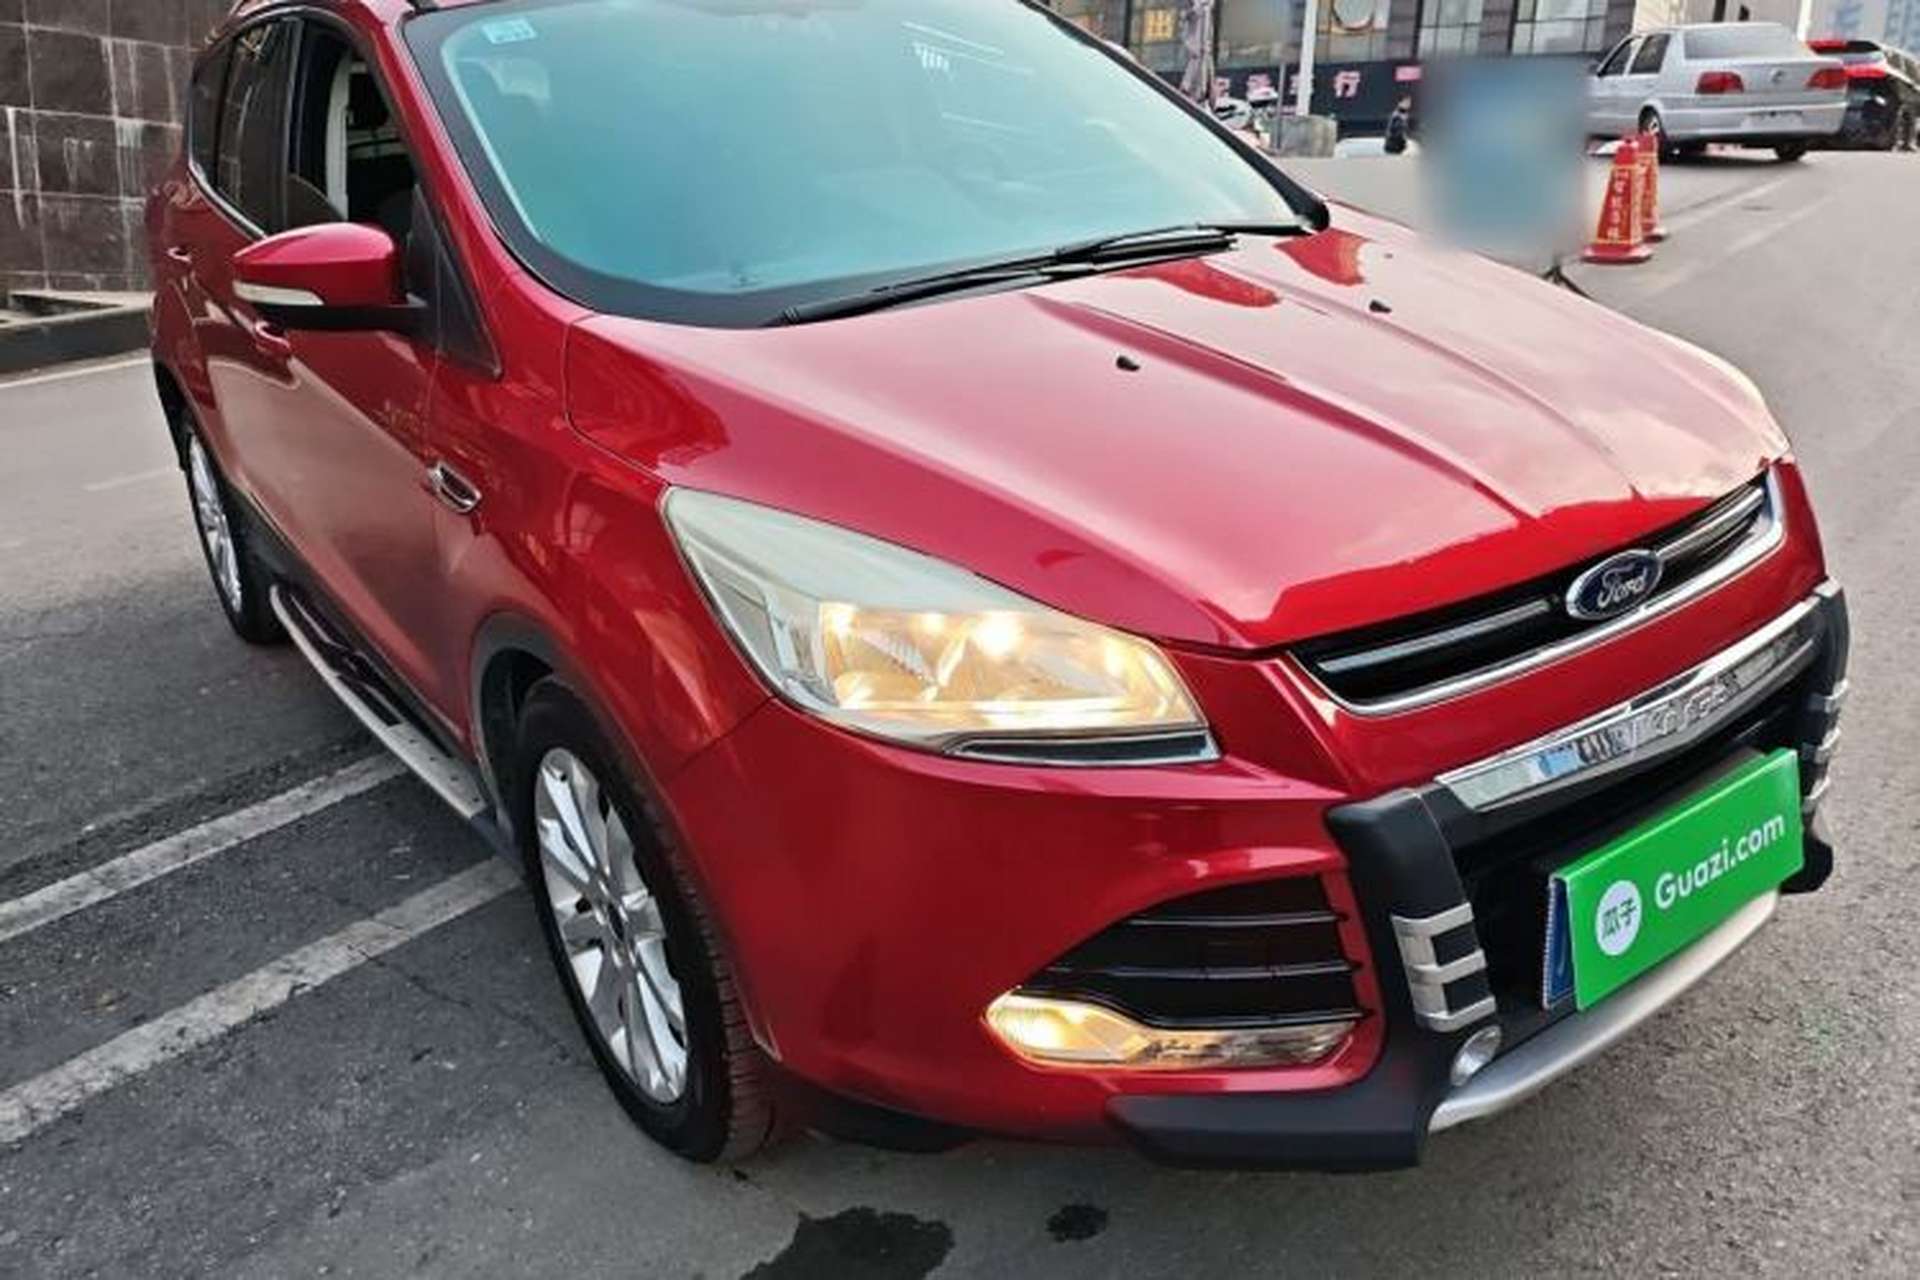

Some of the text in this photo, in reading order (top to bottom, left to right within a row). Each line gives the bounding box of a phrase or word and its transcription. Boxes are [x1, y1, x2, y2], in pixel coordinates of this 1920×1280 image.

[1597, 563, 1648, 608] Ford
[1655, 815, 1785, 909] Guazi.com
[1602, 898, 1637, 941] 瓜子
